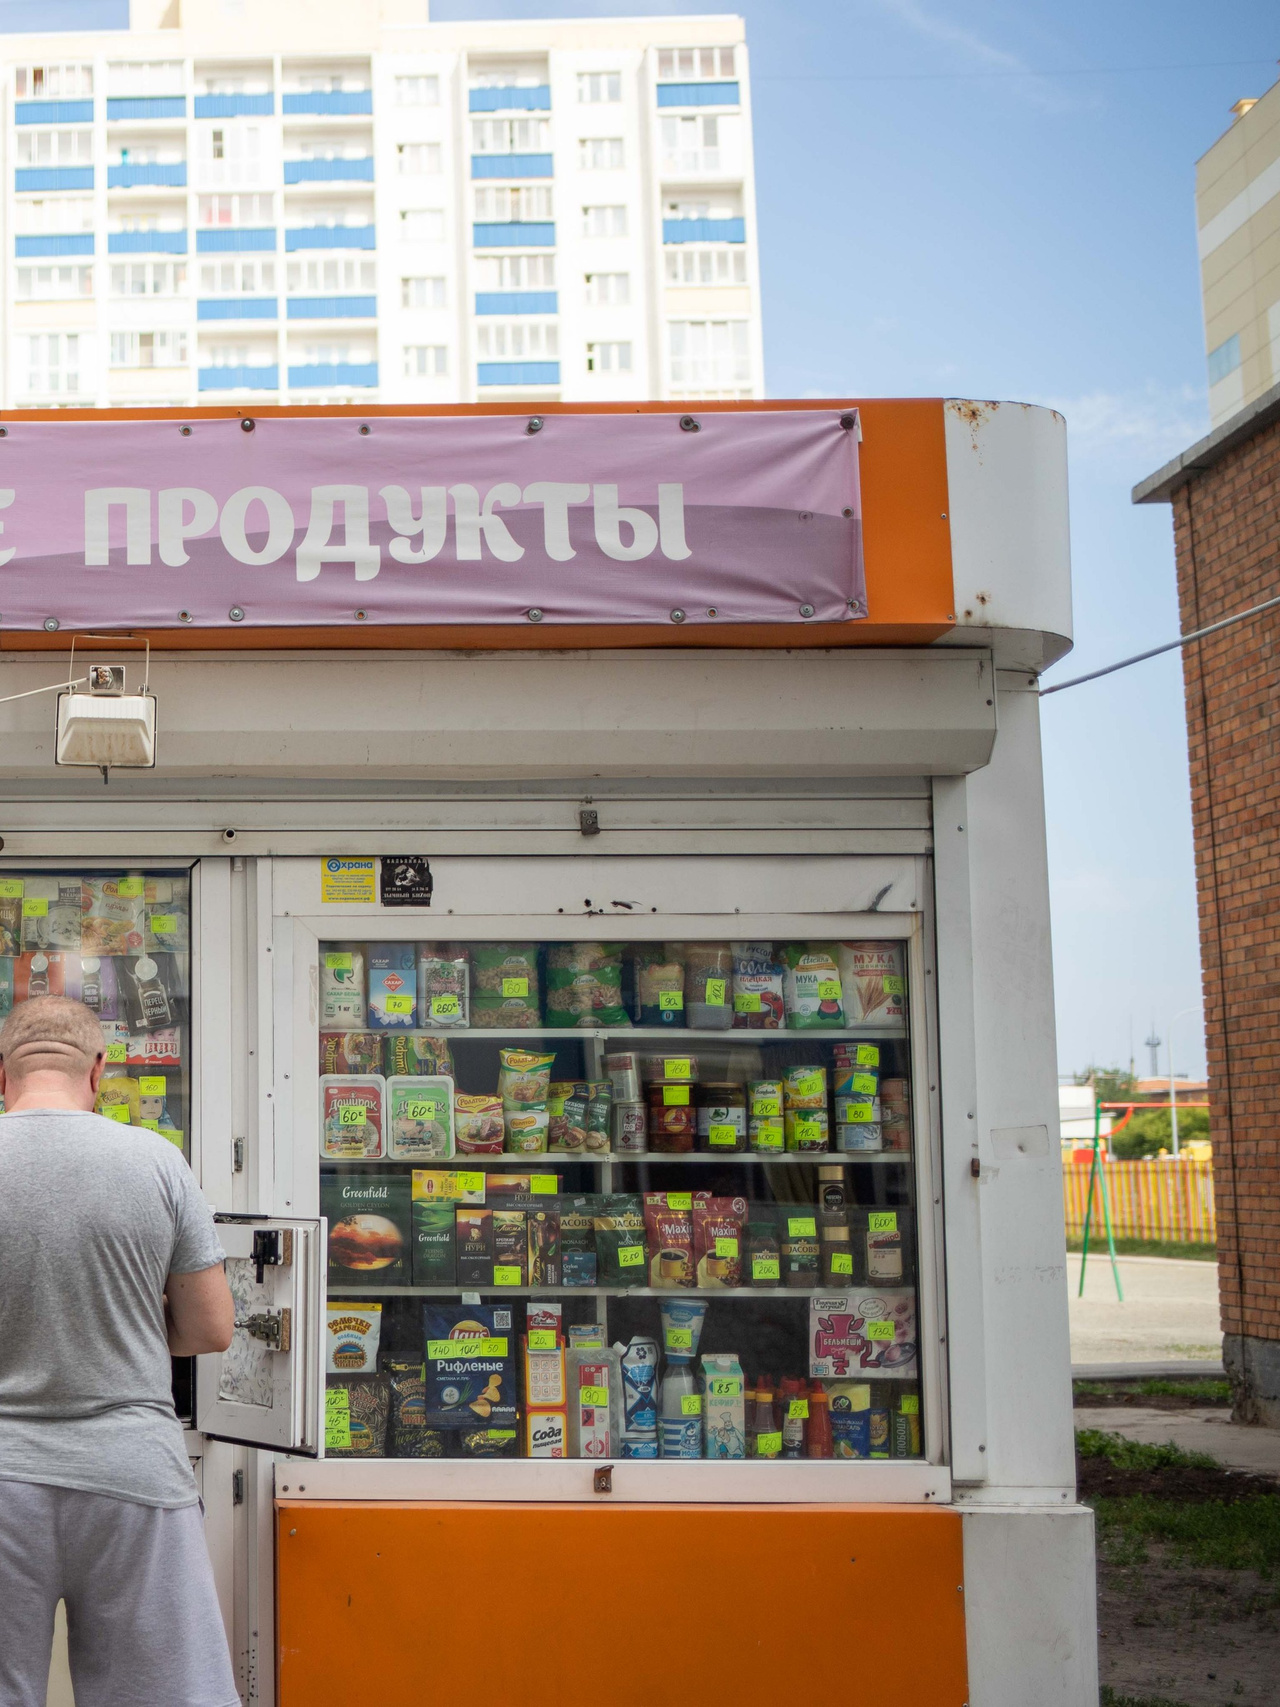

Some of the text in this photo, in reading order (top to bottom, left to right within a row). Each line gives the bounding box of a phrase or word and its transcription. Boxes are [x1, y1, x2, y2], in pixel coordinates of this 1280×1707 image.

[84, 482, 693, 583] ПРОДУКТЫ
[853, 954, 896, 964] МУКА
[740, 960, 771, 974] СОЛЬ
[795, 975, 819, 985] МУКА
[506, 983, 520, 994] 60
[143, 997, 164, 1006] ПЕРЕЦ
[392, 1001, 402, 1009] 70
[741, 1001, 752, 1010] 15
[509, 1056, 537, 1065] Роллтон
[755, 1088, 777, 1096] Bonduelle
[459, 1096, 487, 1106] Роллтон
[512, 1119, 535, 1127] Роллтон
[463, 1177, 474, 1188] 75
[342, 1185, 389, 1199] Greenfield
[561, 1219, 593, 1227] ACOBS
[711, 1226, 737, 1237] Maxim
[418, 1233, 450, 1243] Greenfield
[465, 1244, 486, 1252] НУРИ
[788, 1245, 818, 1254] JACOBS
[622, 1252, 639, 1263] 250
[501, 1274, 509, 1282] 50
[823, 1337, 863, 1347] БЕЛЬМЕШИ
[432, 1346, 450, 1355] 140
[486, 1344, 499, 1353] 50
[436, 1360, 504, 1374] Рифленые
[716, 1382, 734, 1394] 85
[584, 1391, 599, 1403] 90
[709, 1399, 734, 1407] КЕФИР
[790, 1405, 805, 1416] 55
[531, 1427, 562, 1442] Сода
[896, 1416, 908, 1458] СЛОБОДА
[531, 1438, 562, 1450] пищевая
[763, 1436, 777, 1451] 50
